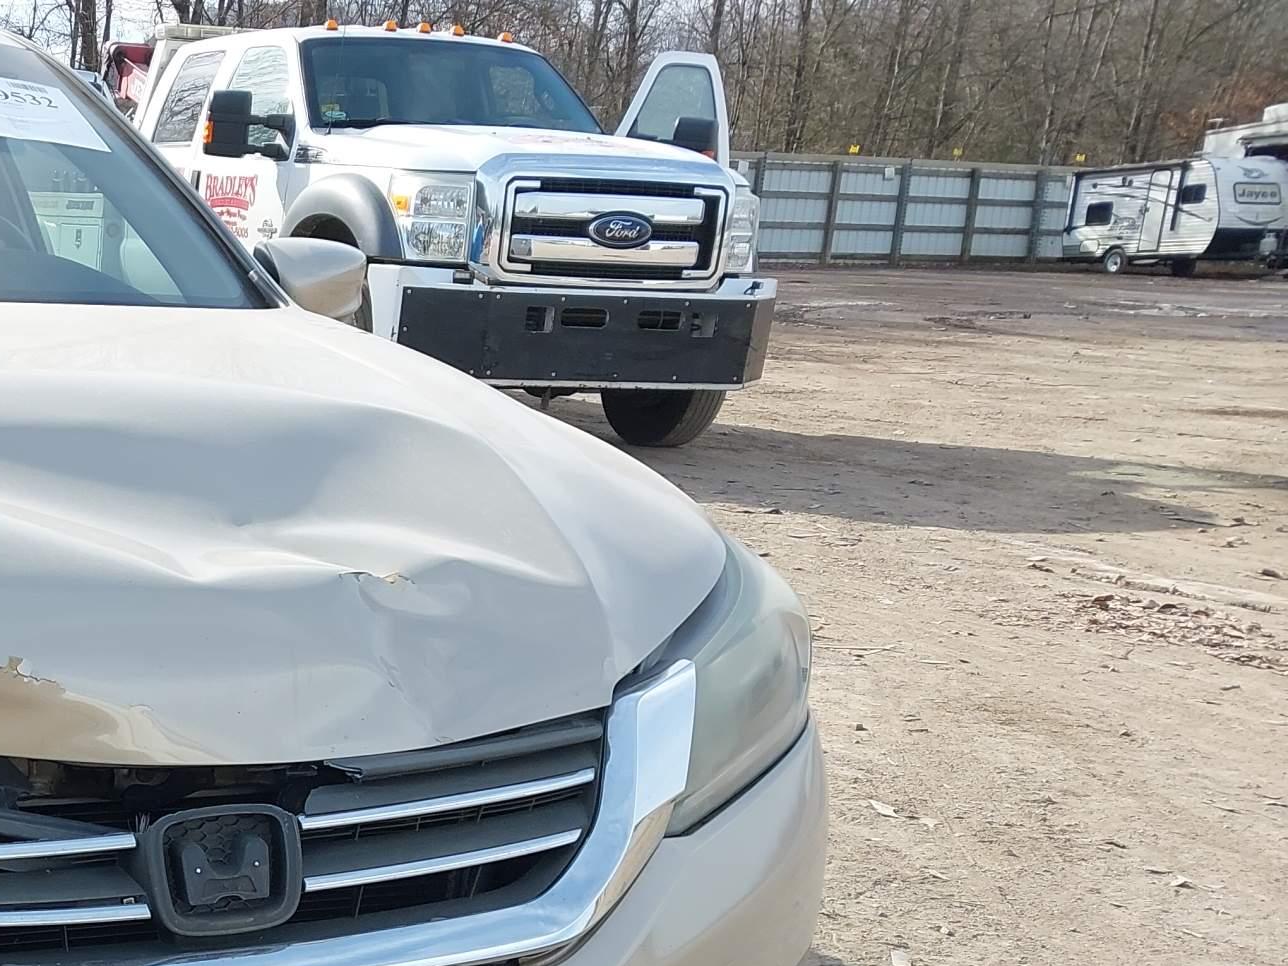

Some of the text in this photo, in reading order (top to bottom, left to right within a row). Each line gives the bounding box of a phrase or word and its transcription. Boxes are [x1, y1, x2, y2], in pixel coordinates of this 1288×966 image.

[205, 174, 258, 206] BRADLEY'S
[1237, 187, 1278, 200] Jayco
[605, 219, 640, 239] Ford
